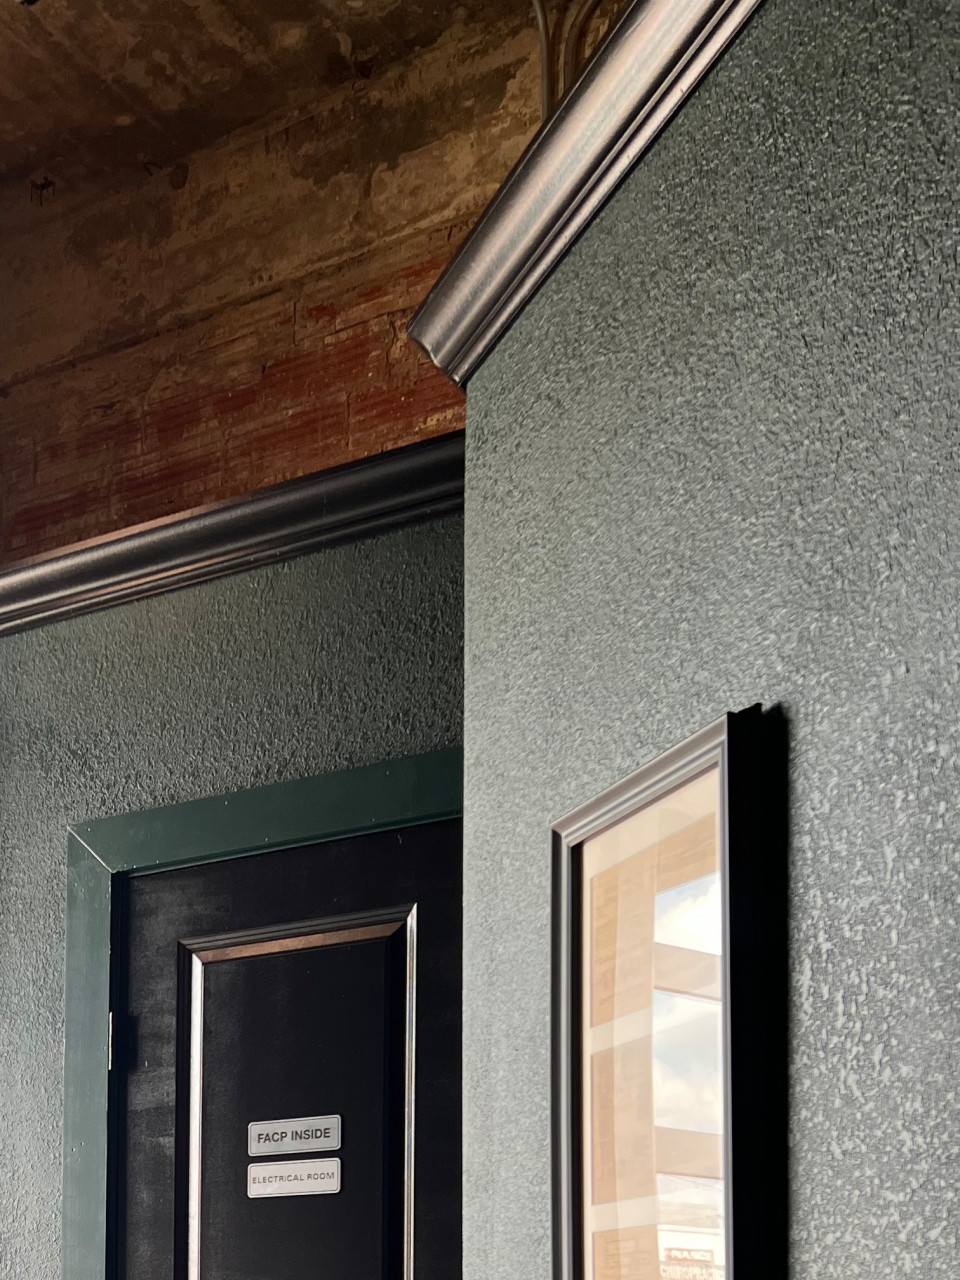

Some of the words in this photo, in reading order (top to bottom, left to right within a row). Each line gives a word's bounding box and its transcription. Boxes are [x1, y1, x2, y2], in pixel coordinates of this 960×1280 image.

[257, 1131, 288, 1143] FACP
[291, 1127, 331, 1141] INSIDE
[252, 1174, 304, 1184] ELECTRICAL
[307, 1172, 335, 1180] ROOM
